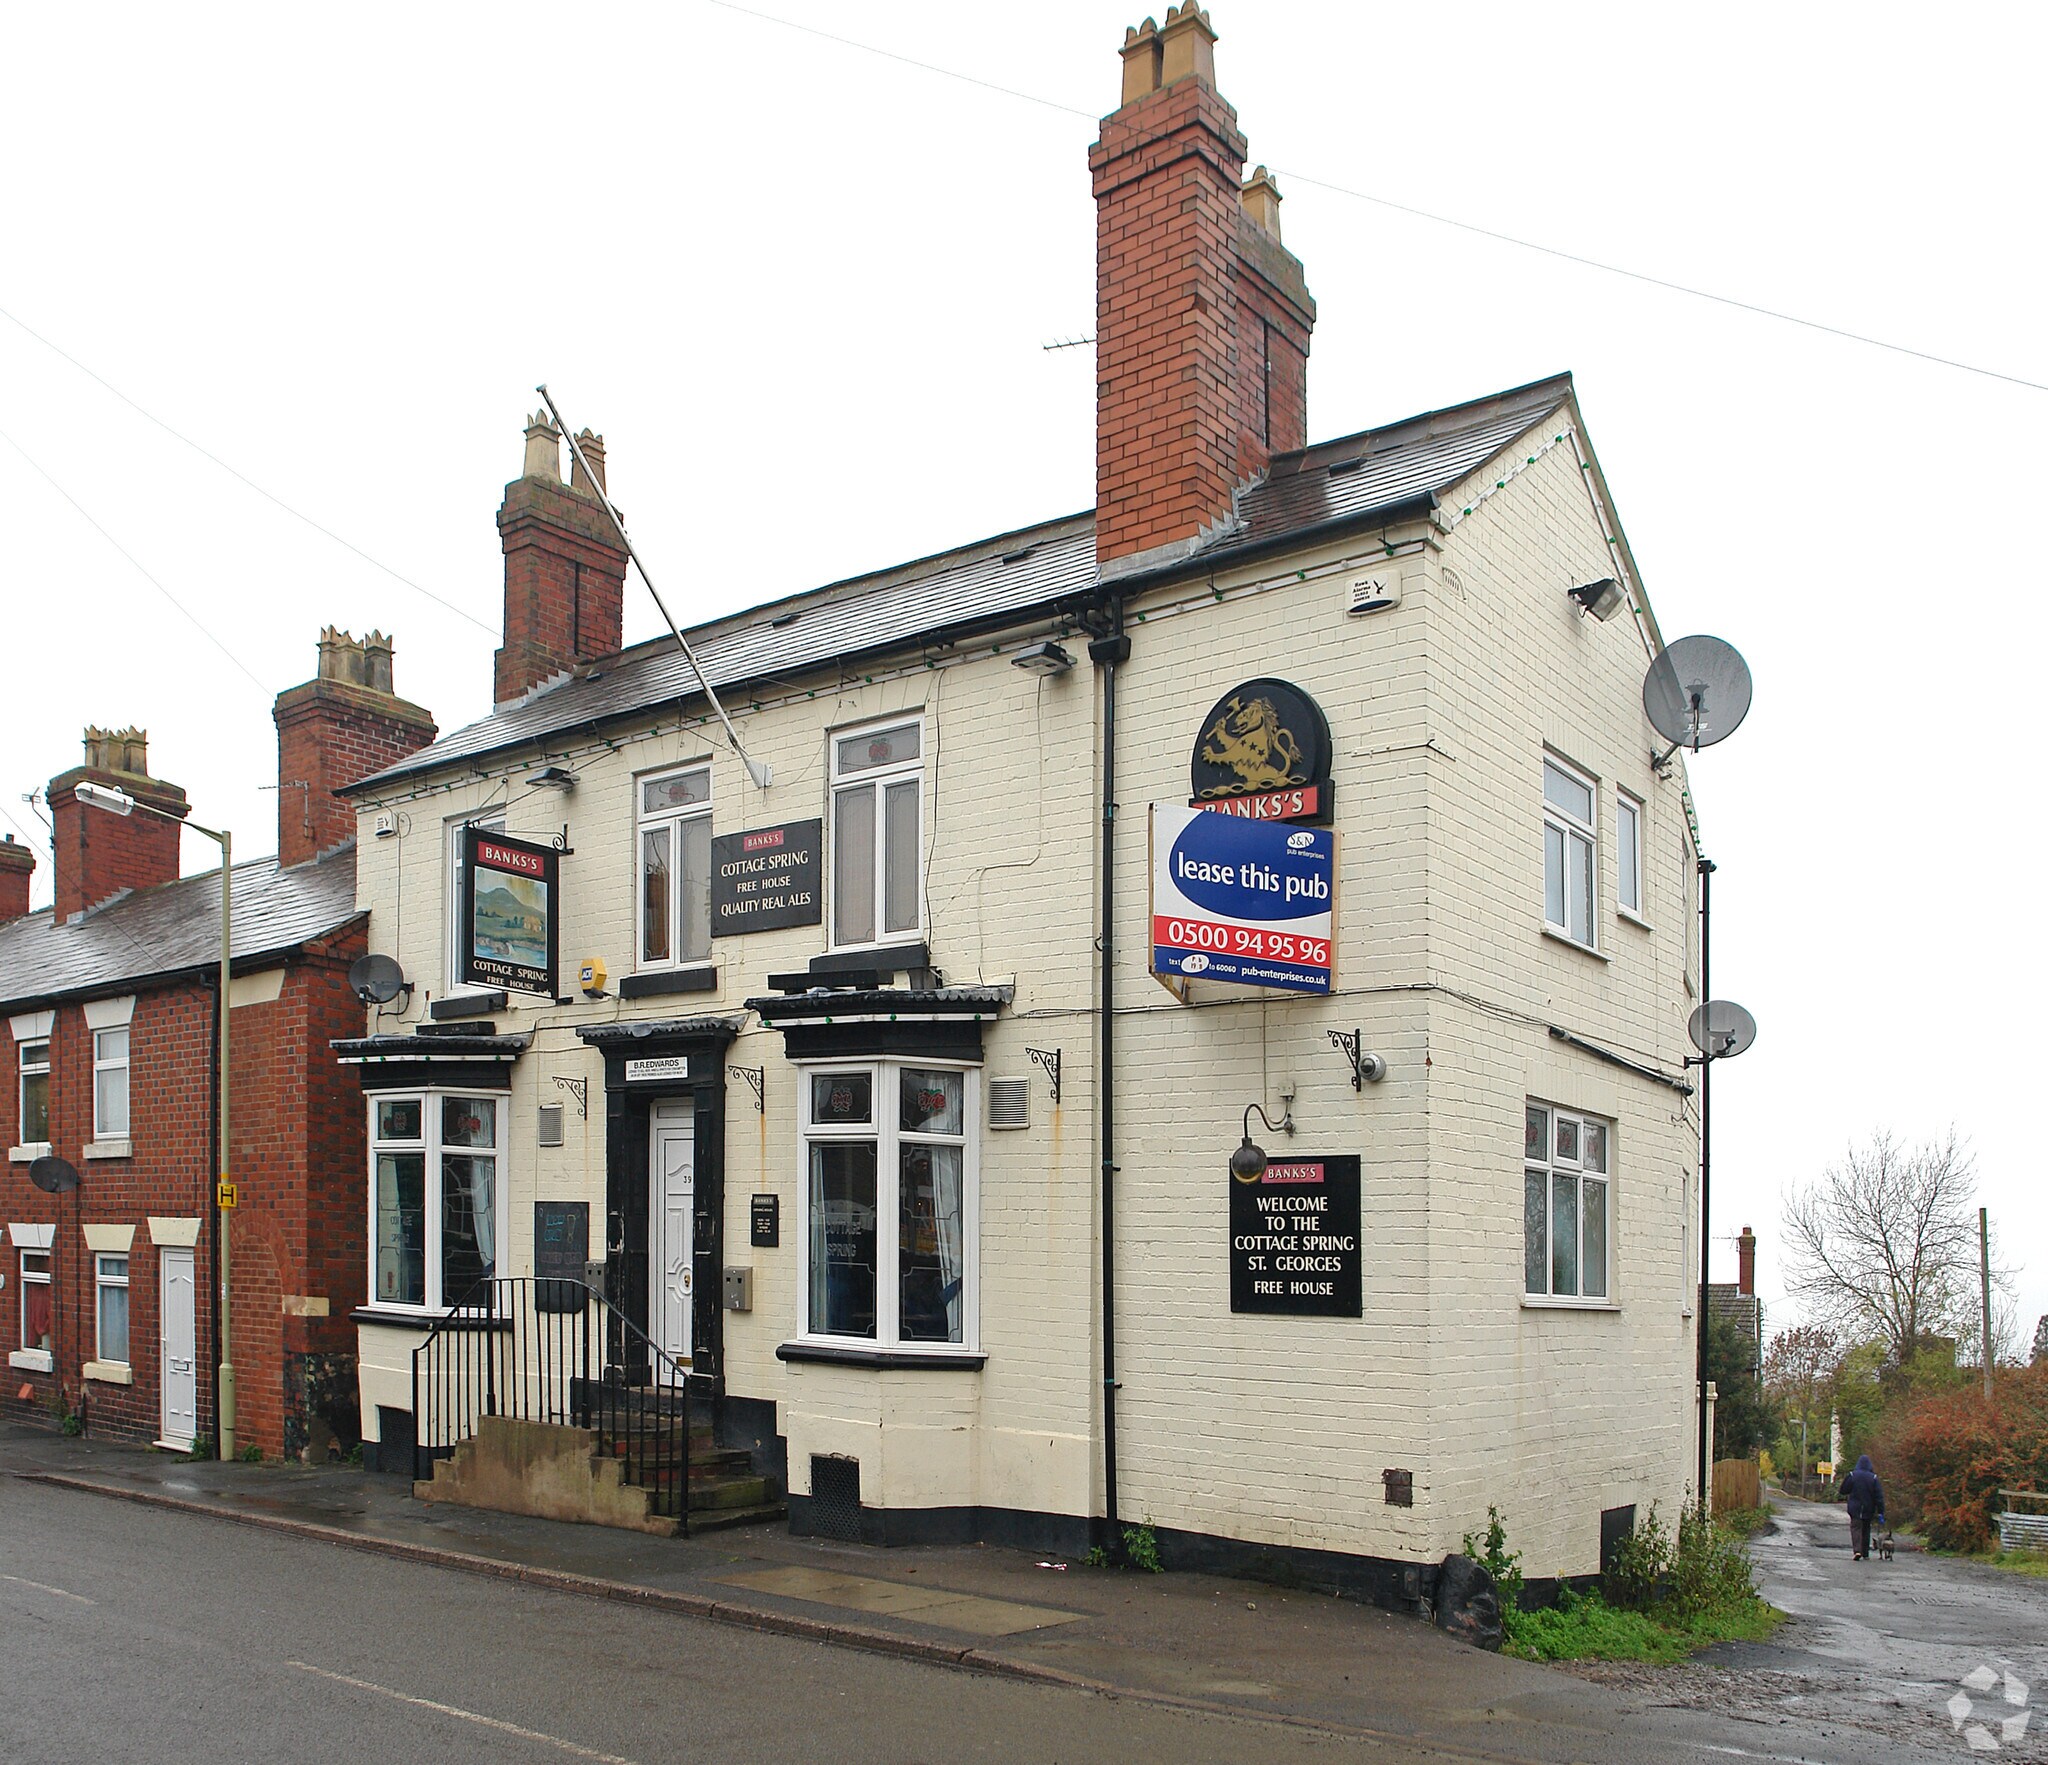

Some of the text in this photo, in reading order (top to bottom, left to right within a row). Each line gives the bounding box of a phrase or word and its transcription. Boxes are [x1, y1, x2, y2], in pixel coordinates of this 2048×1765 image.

[748, 833, 779, 847] BANKS'S
[485, 846, 538, 870] BANKS'S
[1286, 848, 1325, 860] pub enterprises
[721, 850, 809, 877] COTTAGE SPRING
[737, 875, 791, 893] FREE HOUSE
[1178, 852, 1329, 902] lease this pub
[721, 892, 811, 917] QUALITY REAL ALES
[1168, 920, 1327, 963] 0500 94 95 96
[473, 960, 548, 982] COTTAGE SPRING
[1168, 957, 1181, 966] text
[1216, 964, 1237, 973] 60060
[1241, 966, 1327, 985] pub-enterprises.co.uk
[486, 975, 535, 990] FREE HOUSE
[683, 1175, 692, 1184] 39
[1268, 1167, 1316, 1179] BANKS'S
[220, 1186, 234, 1204] H
[1256, 1196, 1328, 1212] WELCOME
[1264, 1216, 1320, 1231] TO THE
[827, 1243, 857, 1257] SPRING
[1234, 1235, 1355, 1251] COTTAGE SPRING
[1248, 1256, 1342, 1272] ST. GEORGES
[1254, 1280, 1334, 1295] FREE HOUSE
